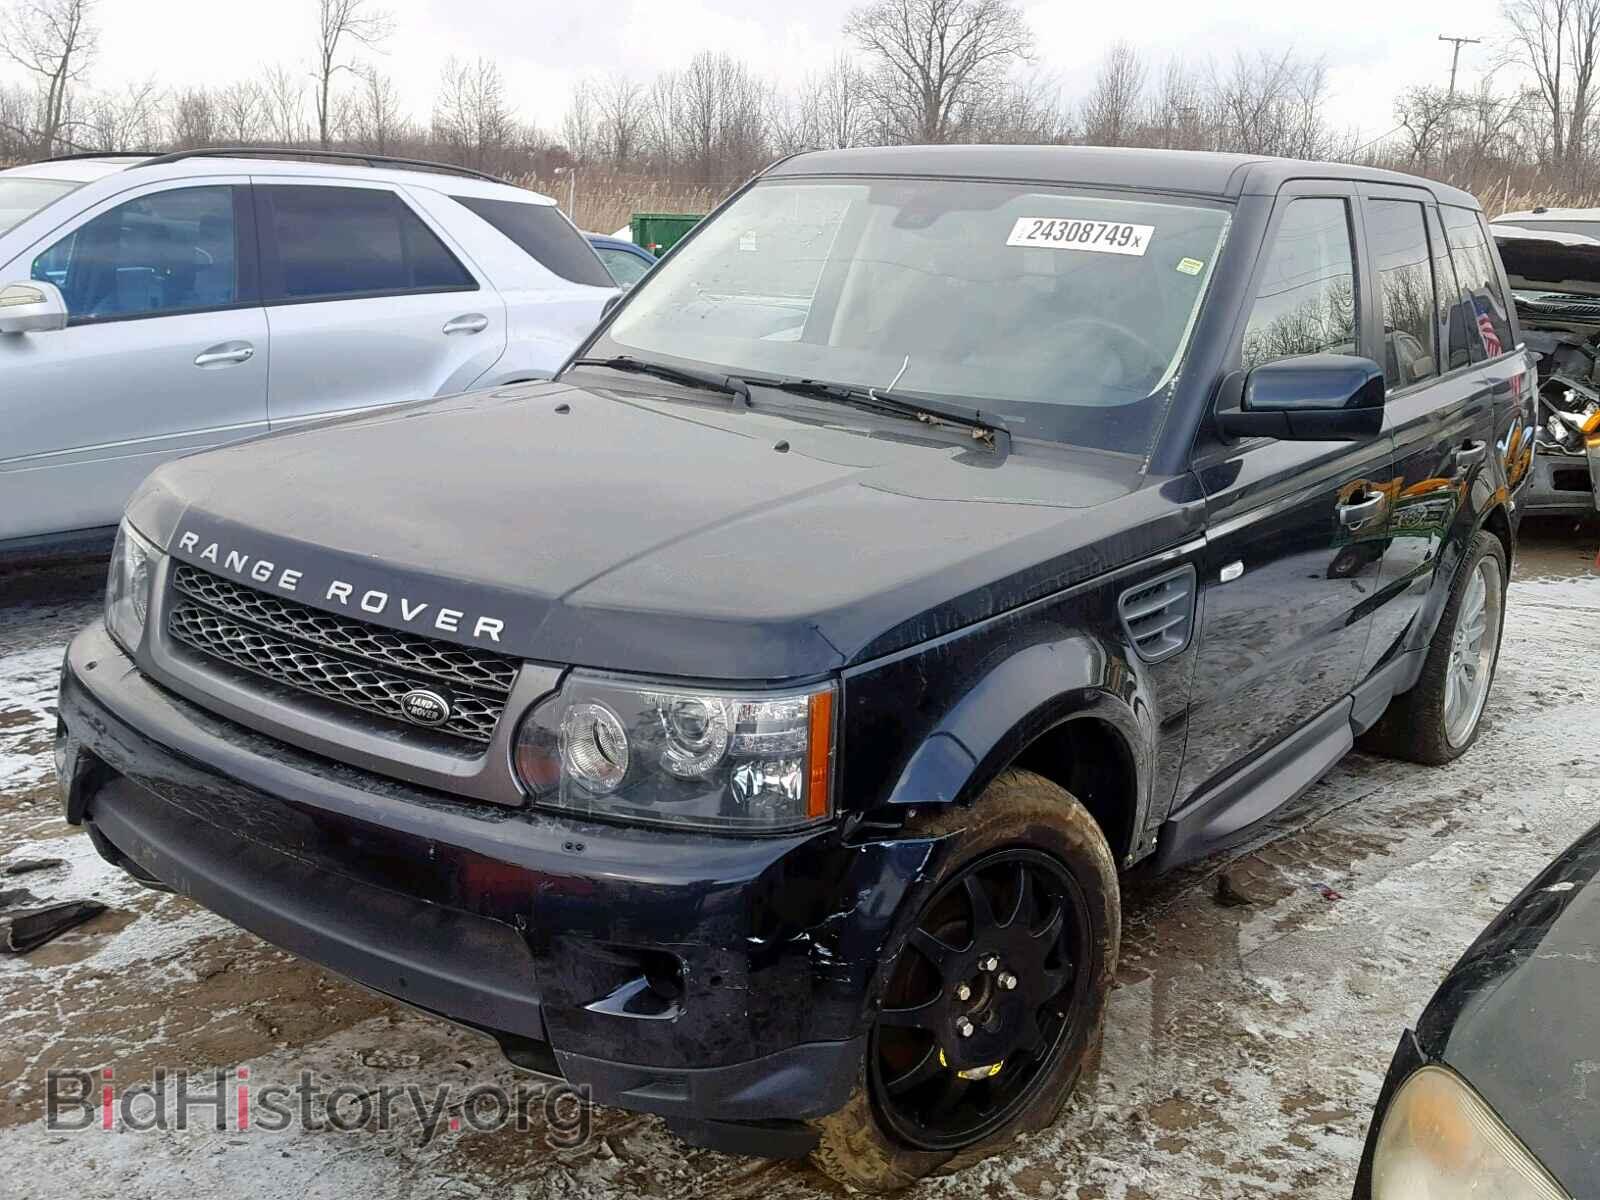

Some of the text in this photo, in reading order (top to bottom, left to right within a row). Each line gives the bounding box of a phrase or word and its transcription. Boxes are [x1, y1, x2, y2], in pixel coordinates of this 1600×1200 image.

[178, 530, 505, 642] RANGE ROVER
[410, 696, 433, 709] LAND
[410, 706, 439, 720] ROVER
